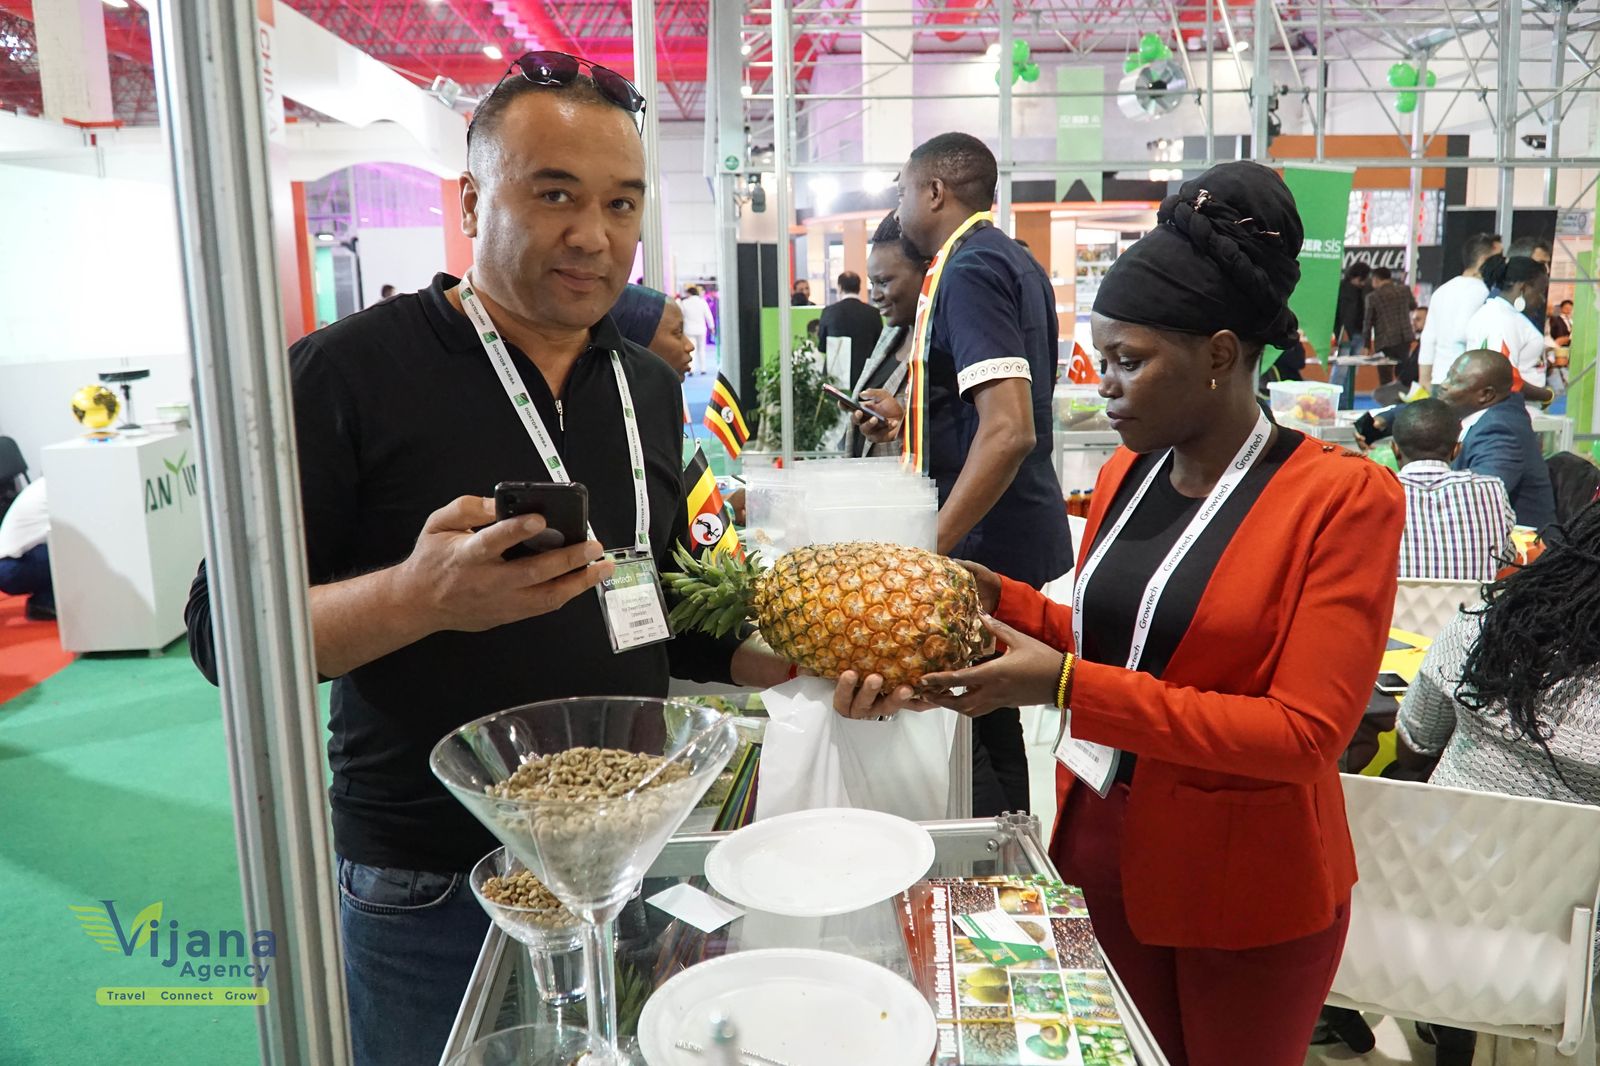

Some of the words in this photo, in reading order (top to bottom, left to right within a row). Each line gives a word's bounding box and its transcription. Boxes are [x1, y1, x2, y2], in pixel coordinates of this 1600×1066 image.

[1234, 432, 1264, 470] Growtech
[1200, 482, 1231, 521] Growtech
[1163, 533, 1194, 573] Growtech
[602, 575, 633, 588] Growtech
[1075, 572, 1090, 615] Growtech
[1138, 585, 1159, 630] Growtech
[930, 886, 947, 909] Supply
[932, 909, 947, 922] We
